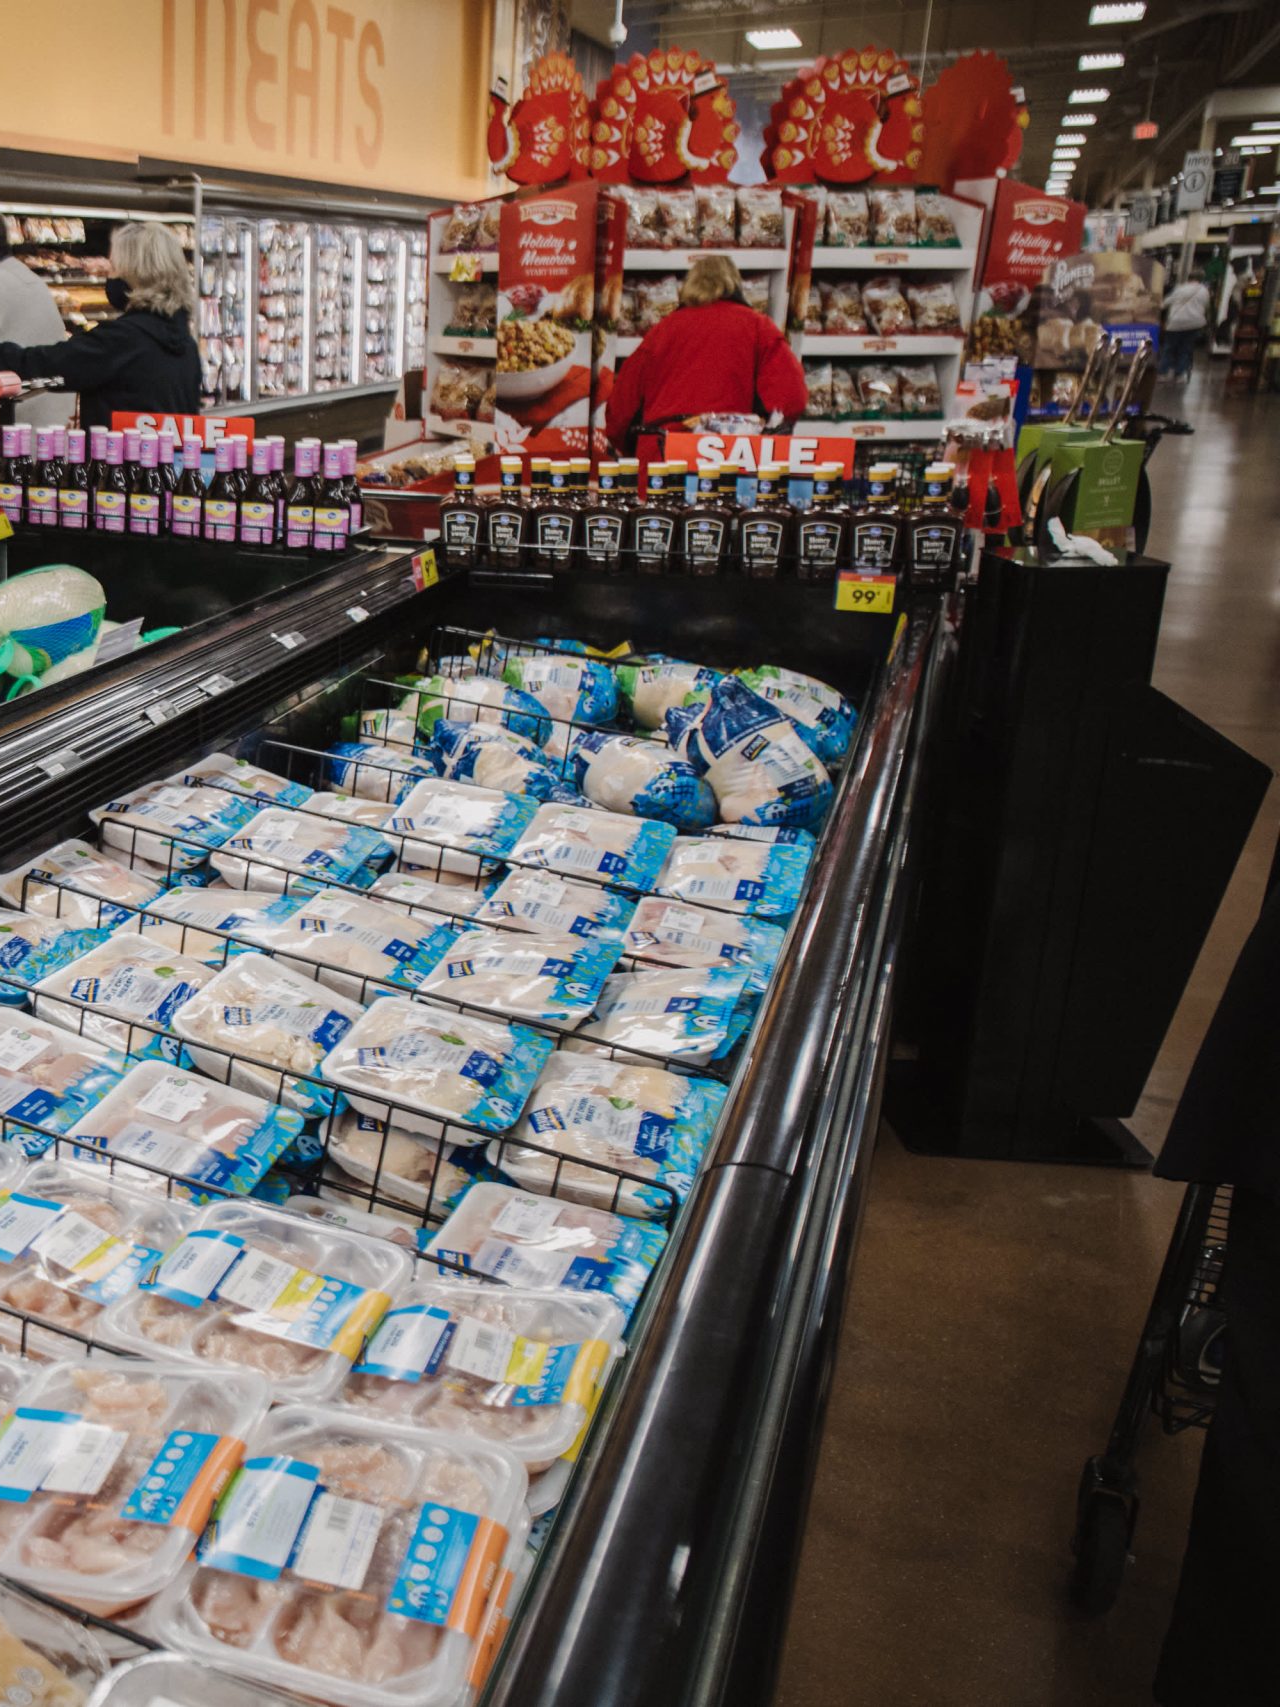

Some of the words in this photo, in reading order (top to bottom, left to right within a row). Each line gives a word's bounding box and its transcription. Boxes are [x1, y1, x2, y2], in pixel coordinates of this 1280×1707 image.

[161, 0, 385, 169] MEATS
[519, 231, 565, 254] Holiday
[1009, 231, 1051, 253] Holiday
[521, 250, 576, 266] Memories
[135, 415, 227, 449] SALE
[696, 437, 819, 474] SALE
